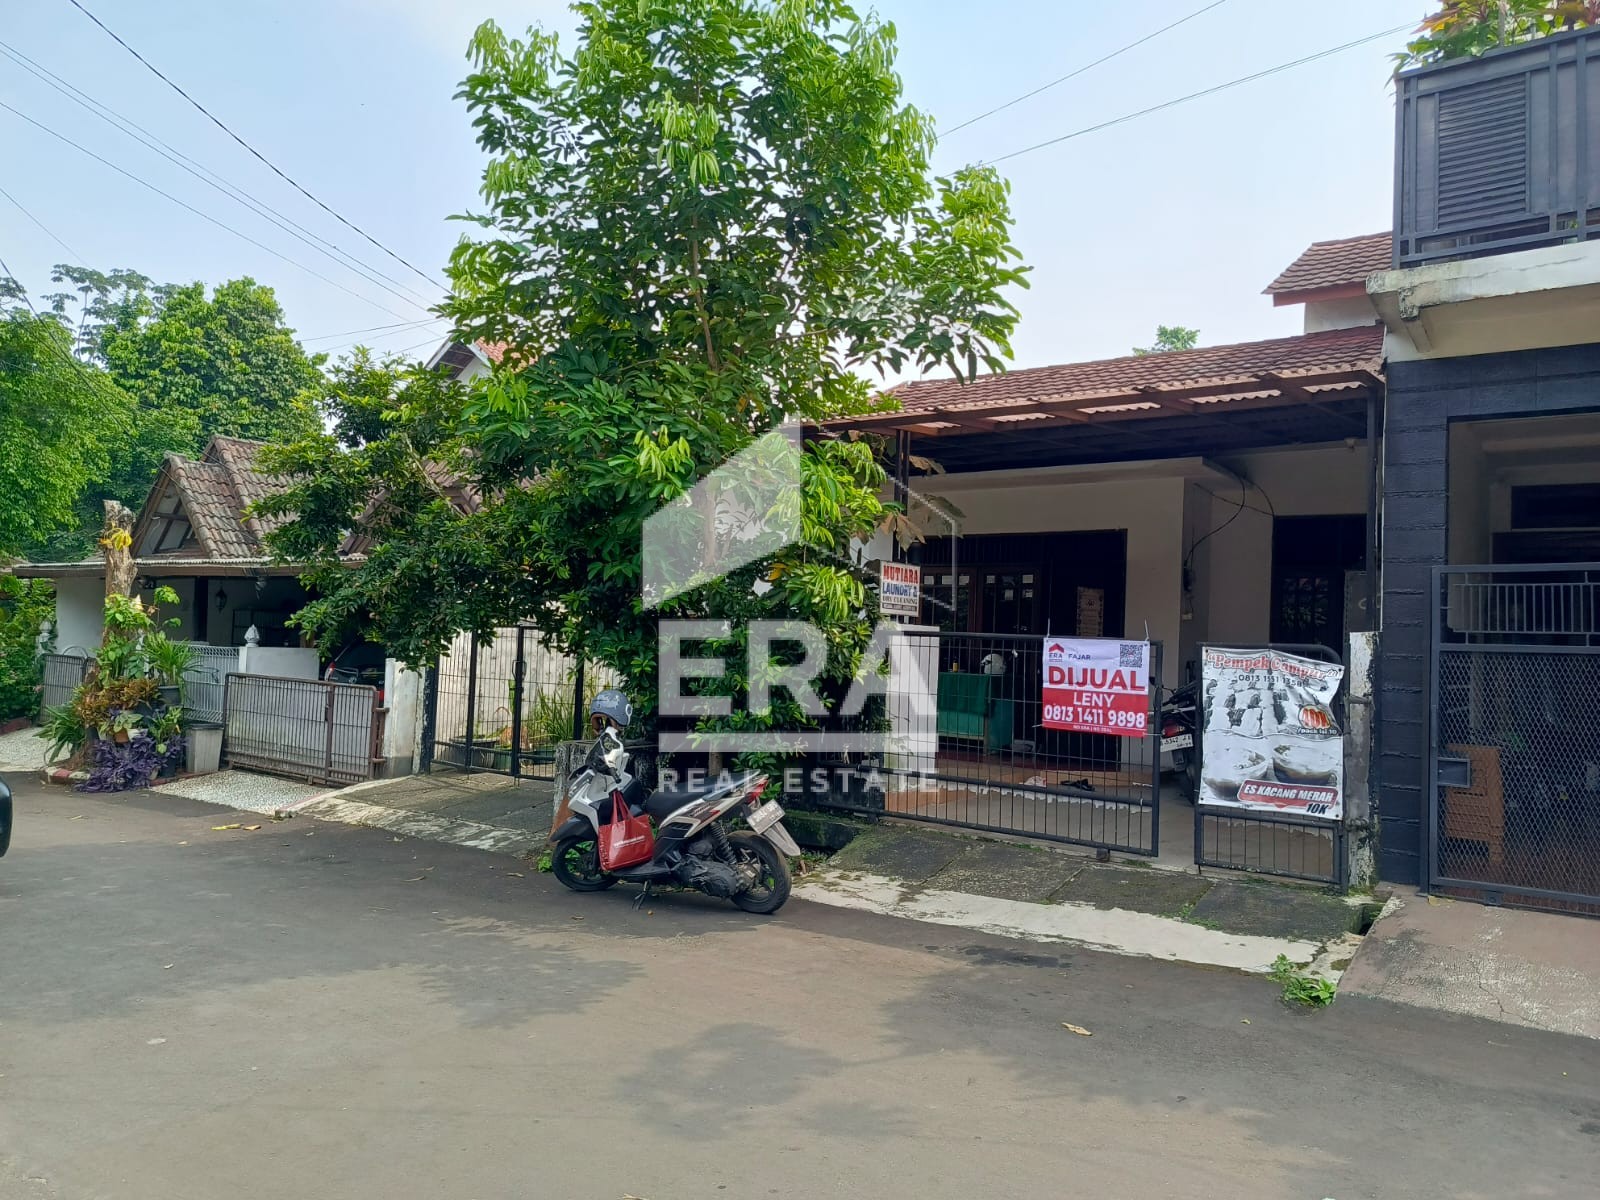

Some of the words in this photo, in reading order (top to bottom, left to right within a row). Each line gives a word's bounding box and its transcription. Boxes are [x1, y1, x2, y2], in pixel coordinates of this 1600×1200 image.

[883, 565, 918, 584] MUTIARA
[1048, 666, 1145, 692] DIJUAL
[1238, 674, 1260, 682] 0813
[1073, 692, 1115, 708] LENY
[1044, 704, 1073, 722] 0813
[1077, 707, 1103, 724] 1411
[1107, 710, 1145, 728] 9898
[1244, 784, 1257, 794] ES
[1256, 786, 1296, 799] KACANG
[1297, 790, 1334, 802] MERAH
[1306, 803, 1329, 815] 10K
